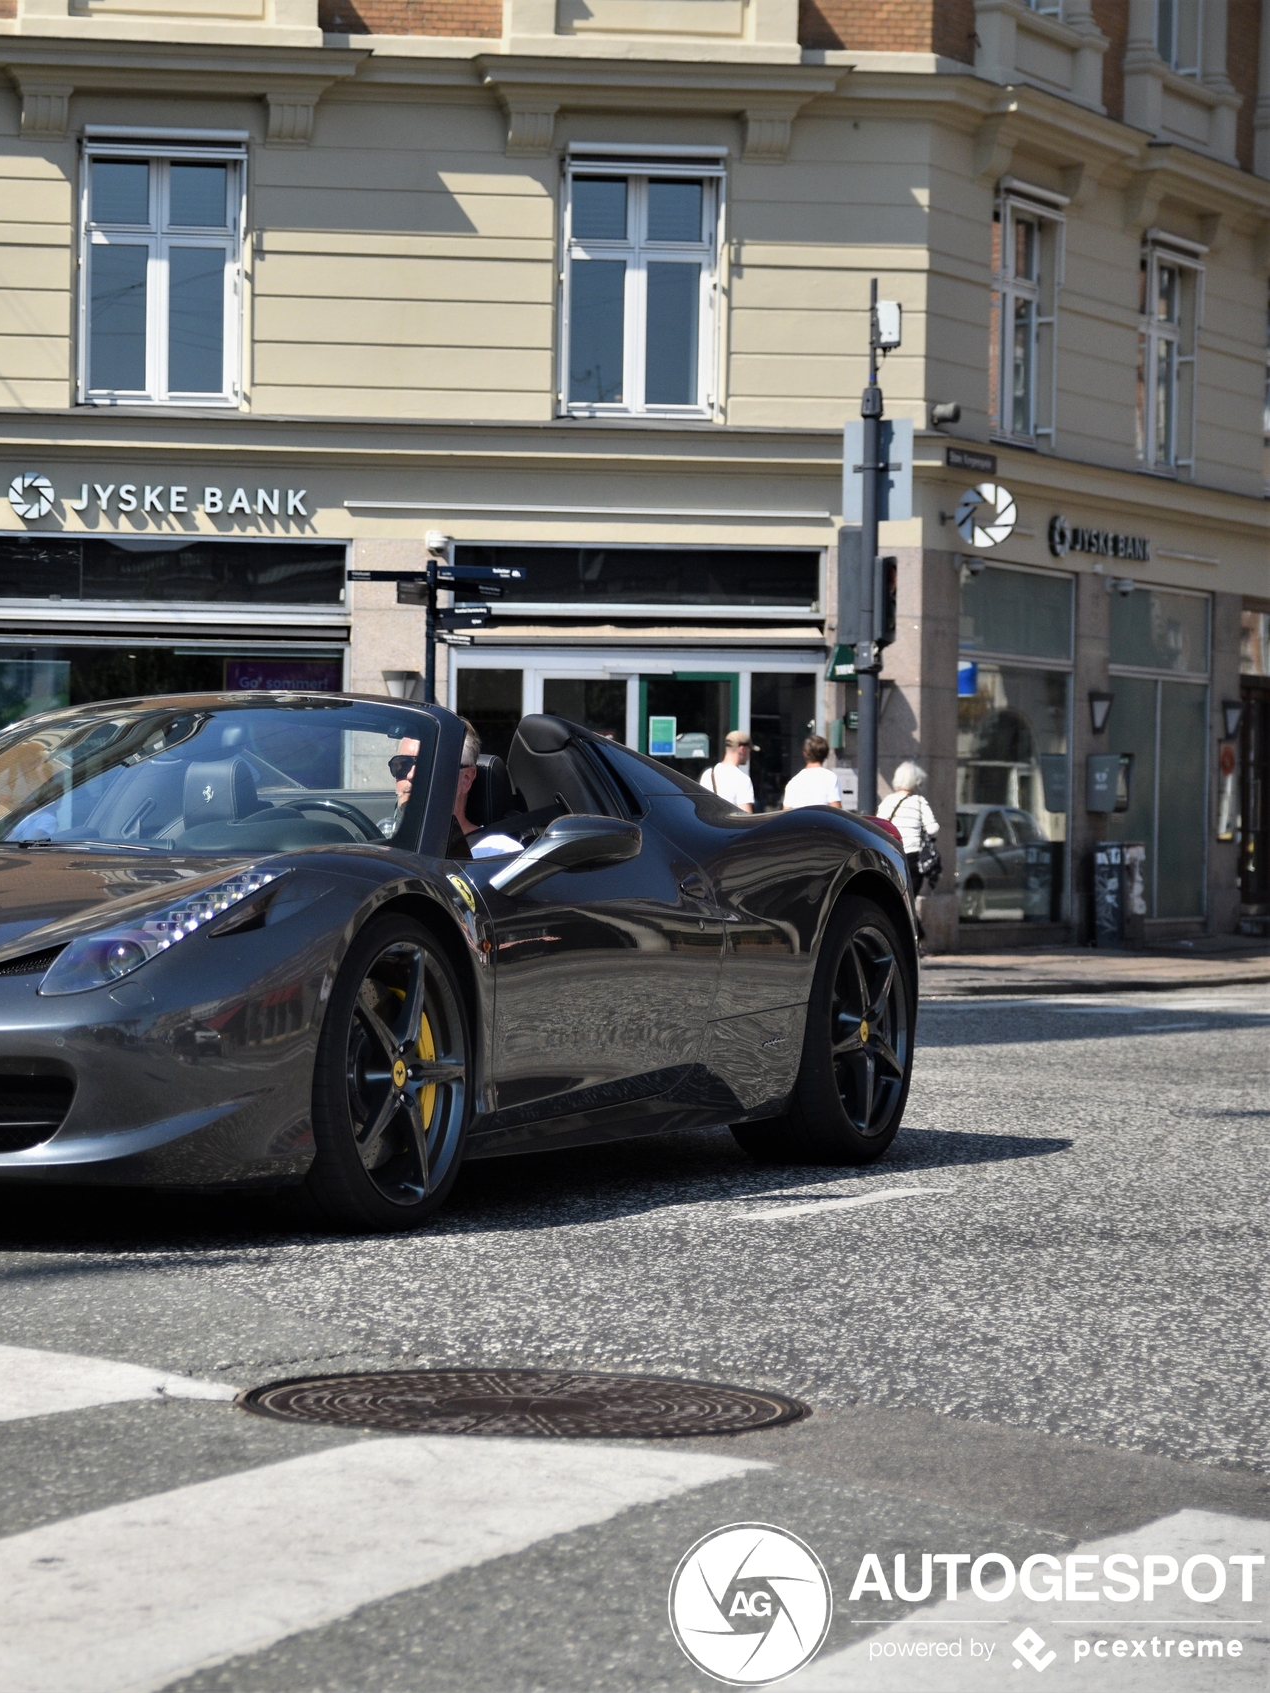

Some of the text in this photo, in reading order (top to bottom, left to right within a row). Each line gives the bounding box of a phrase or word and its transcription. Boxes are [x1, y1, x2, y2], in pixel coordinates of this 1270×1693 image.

[71, 484, 308, 515] JYSKE BANK
[1073, 528, 1150, 560] JYSKE BANK
[266, 678, 328, 690] sommer!
